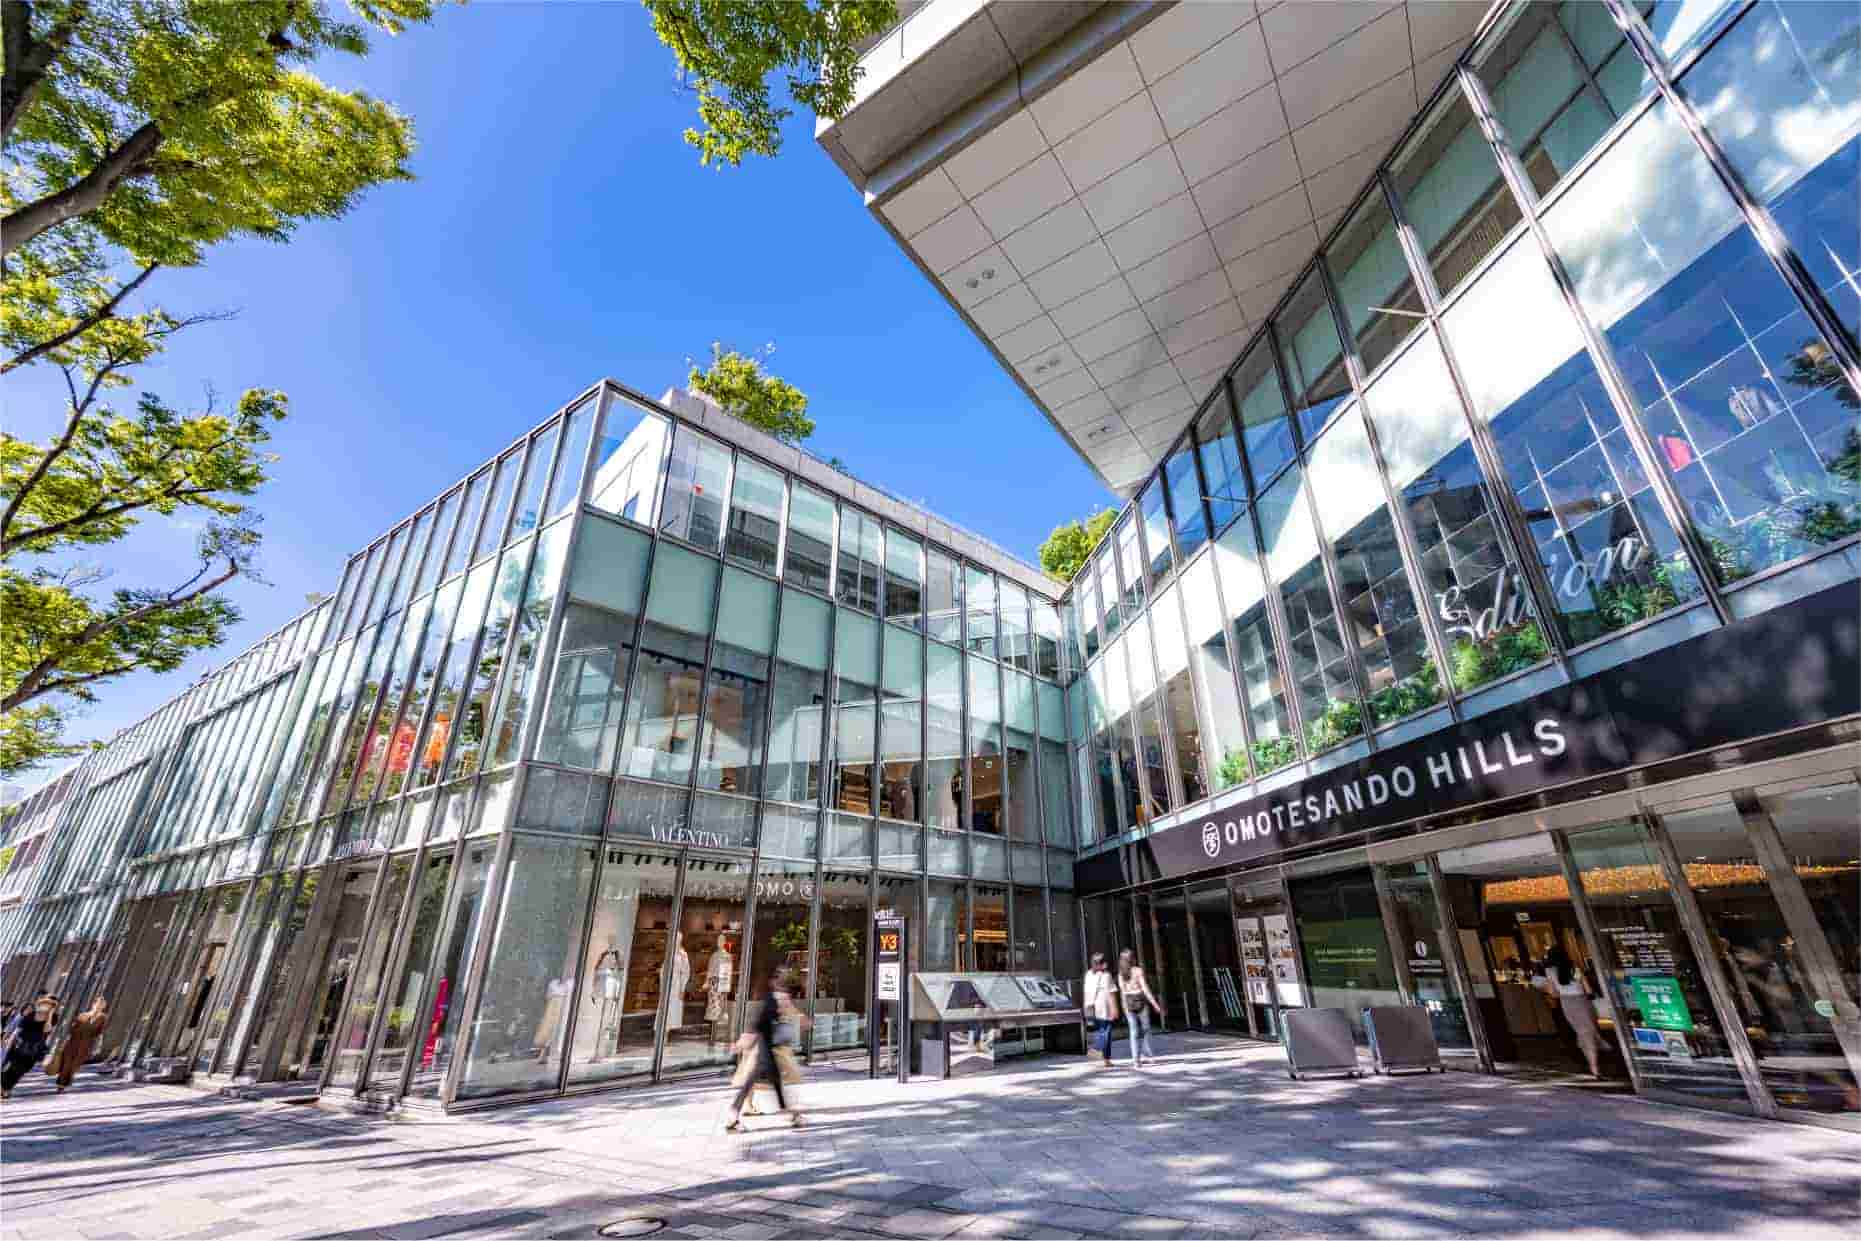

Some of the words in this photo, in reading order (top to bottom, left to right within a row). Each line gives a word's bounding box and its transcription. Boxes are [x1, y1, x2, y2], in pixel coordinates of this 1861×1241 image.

[1434, 536, 1647, 642] Ediion
[1224, 765, 1416, 845] OMOTESANDO
[1426, 718, 1566, 789] HILLS
